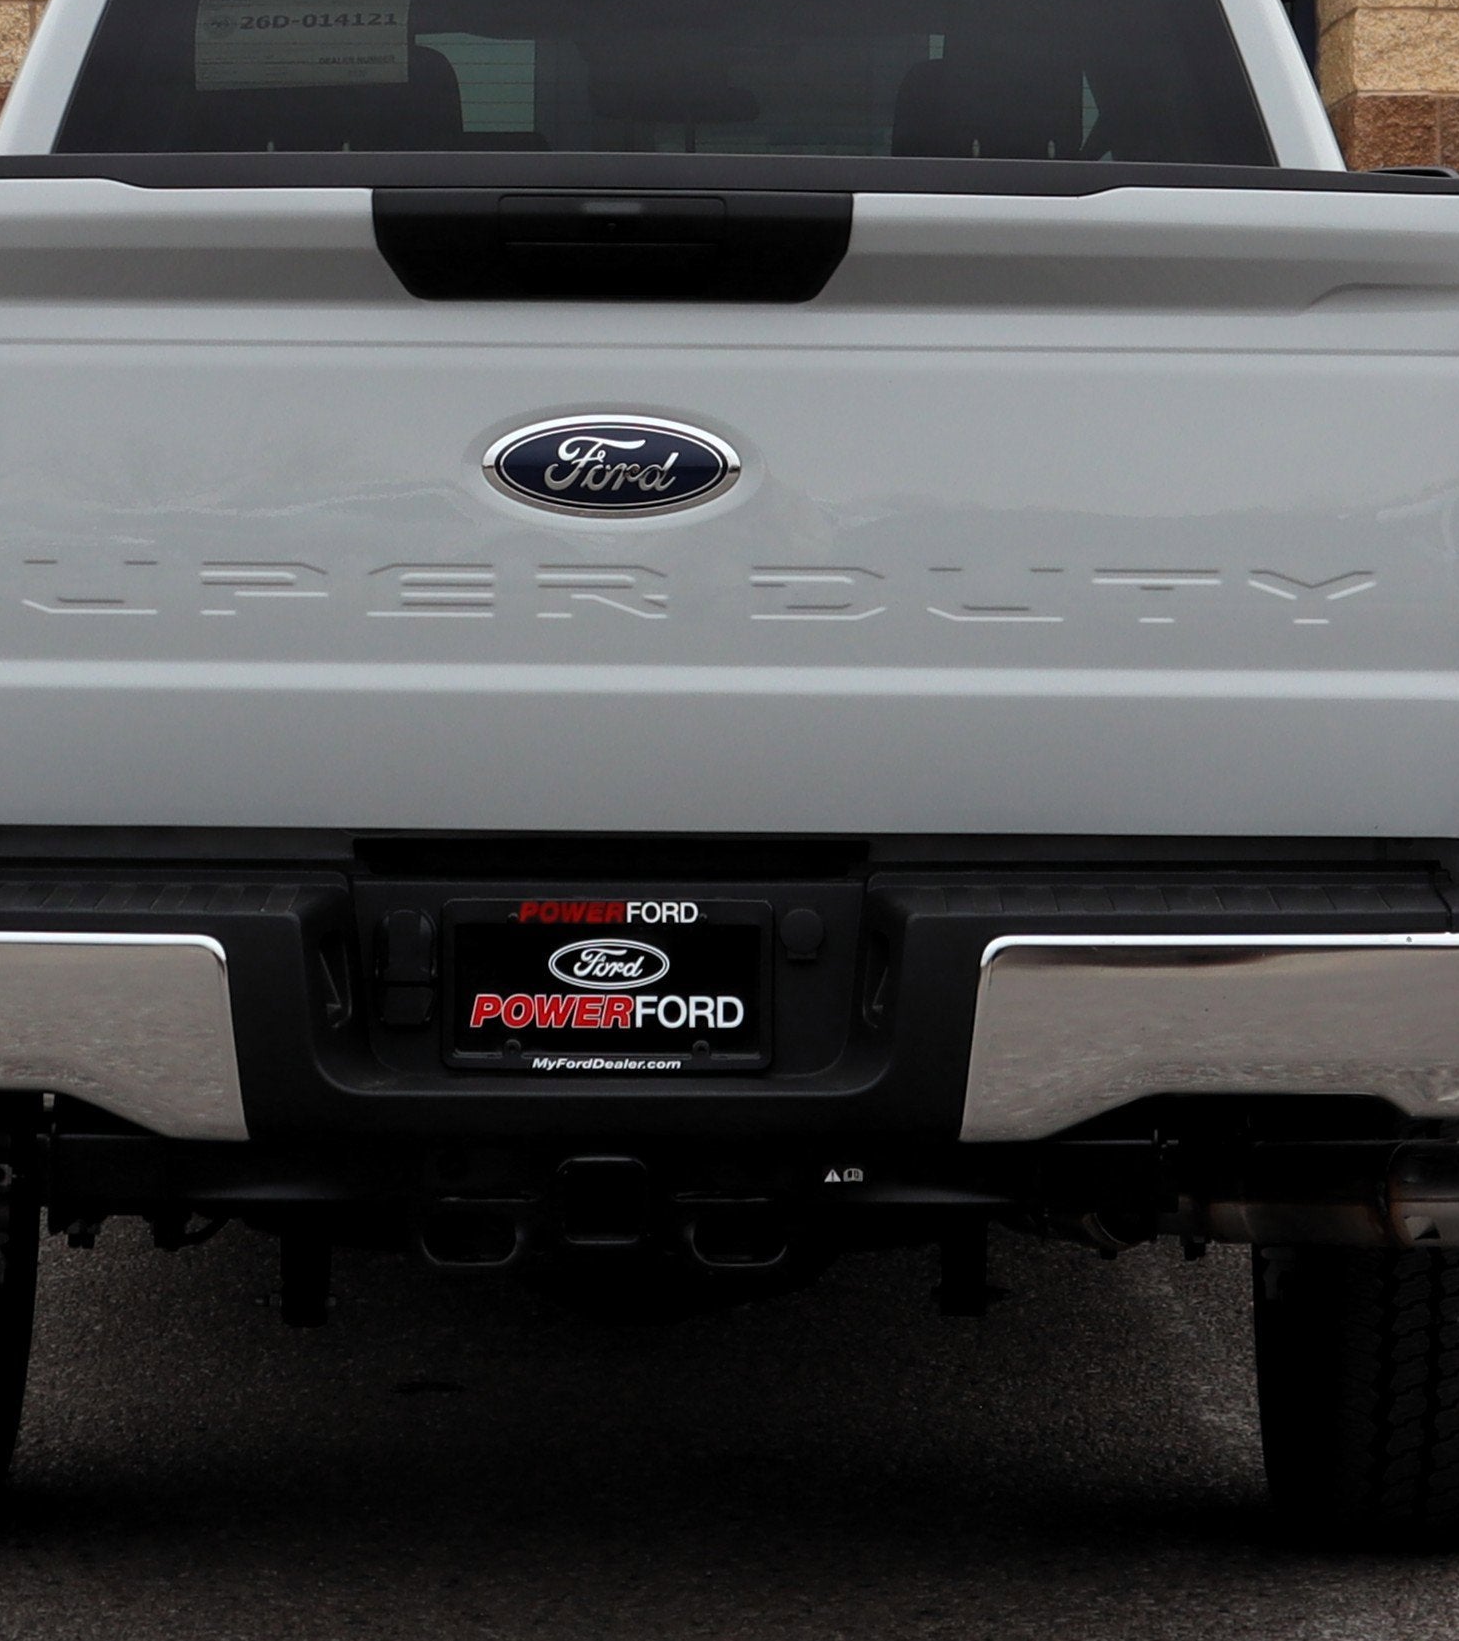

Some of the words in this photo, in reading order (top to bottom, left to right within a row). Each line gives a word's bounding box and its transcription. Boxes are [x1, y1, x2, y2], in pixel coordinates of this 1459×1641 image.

[240, 13, 398, 31] 26D-014121
[544, 436, 679, 491] Ford
[749, 565, 1376, 624] DUTY
[518, 901, 699, 925] POWERFORD
[572, 948, 645, 979] Ford
[470, 994, 745, 1029] POWERFORD
[532, 1057, 682, 1071] MyFordDealer.com
